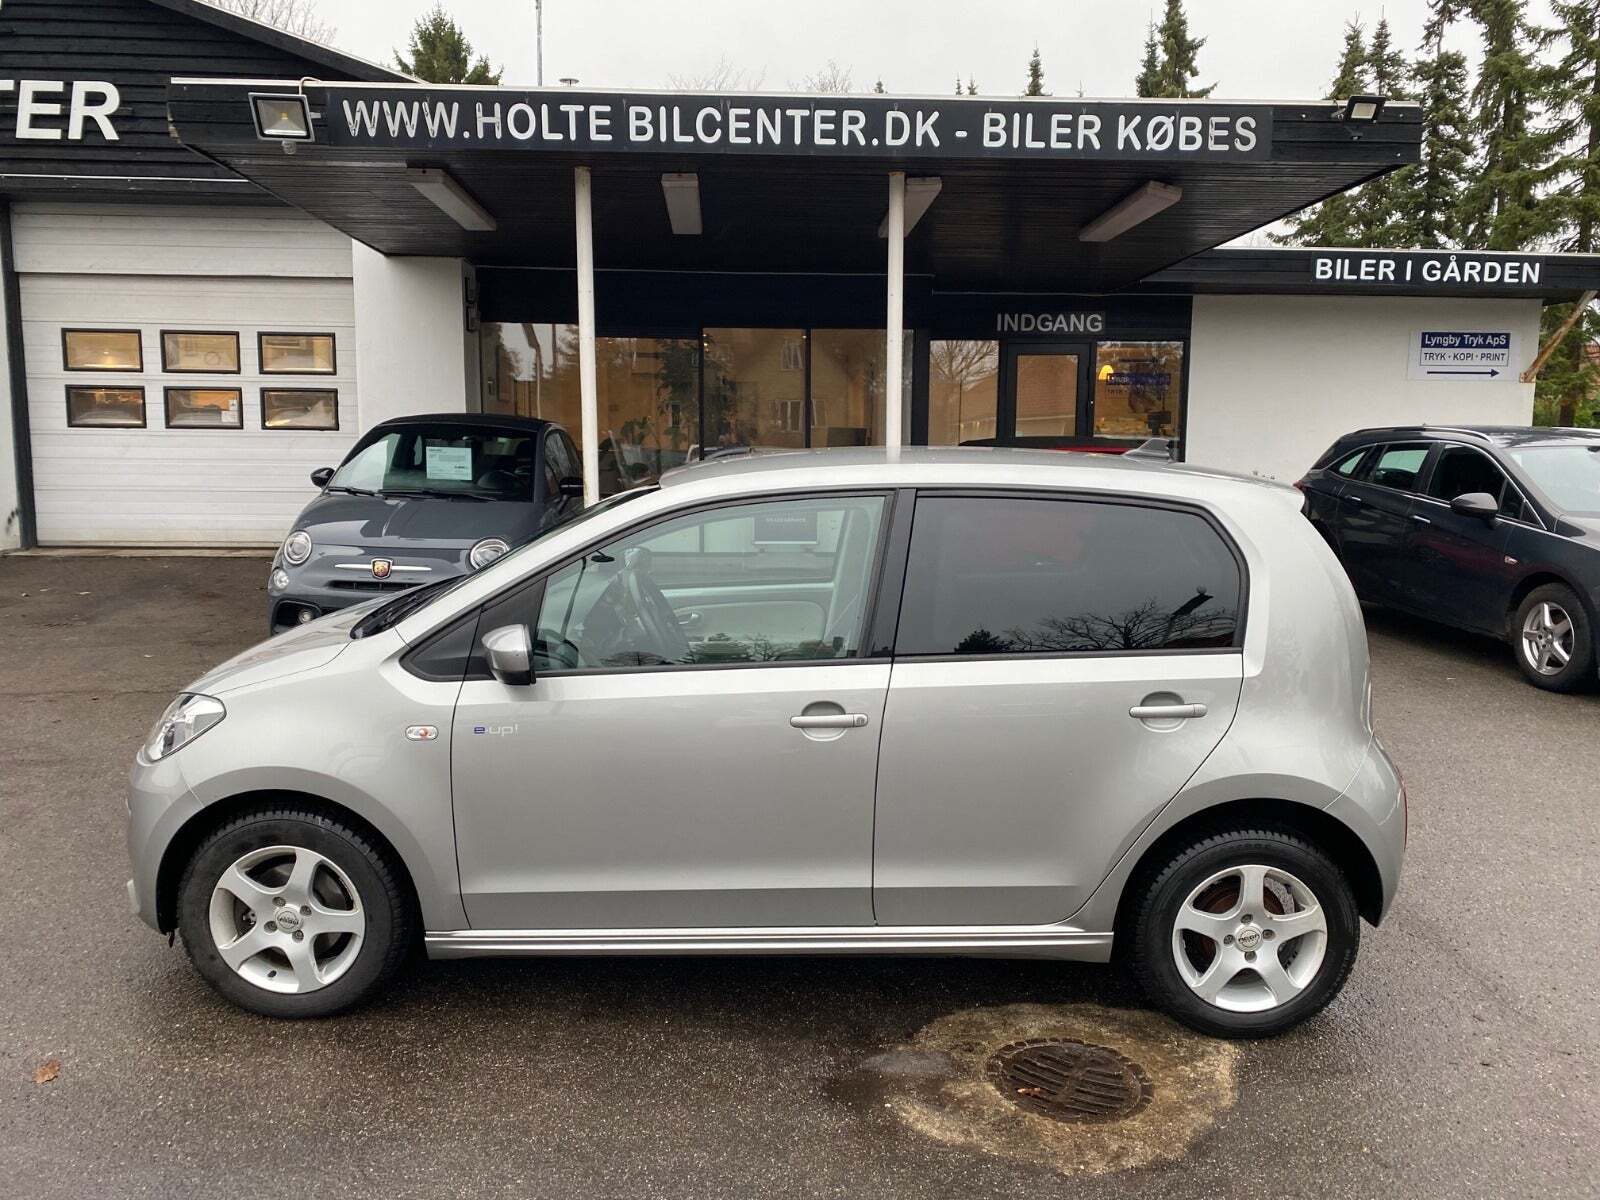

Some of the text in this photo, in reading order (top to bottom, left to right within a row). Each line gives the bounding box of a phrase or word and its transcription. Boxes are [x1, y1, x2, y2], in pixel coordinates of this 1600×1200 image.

[342, 99, 613, 141] WWW.HOLTE
[628, 105, 940, 147] BILCENTER.DK
[983, 112, 1101, 150] BILER
[1117, 114, 1257, 152] KØBES
[1315, 254, 1541, 284] BILER I GÅRDEN
[996, 313, 1103, 333] INDGANG
[1425, 334, 1507, 347] Lyngby Tryk ApS
[1423, 352, 1447, 361] TRYK
[1453, 352, 1474, 361] KOPI
[1480, 352, 1506, 361] PRINT
